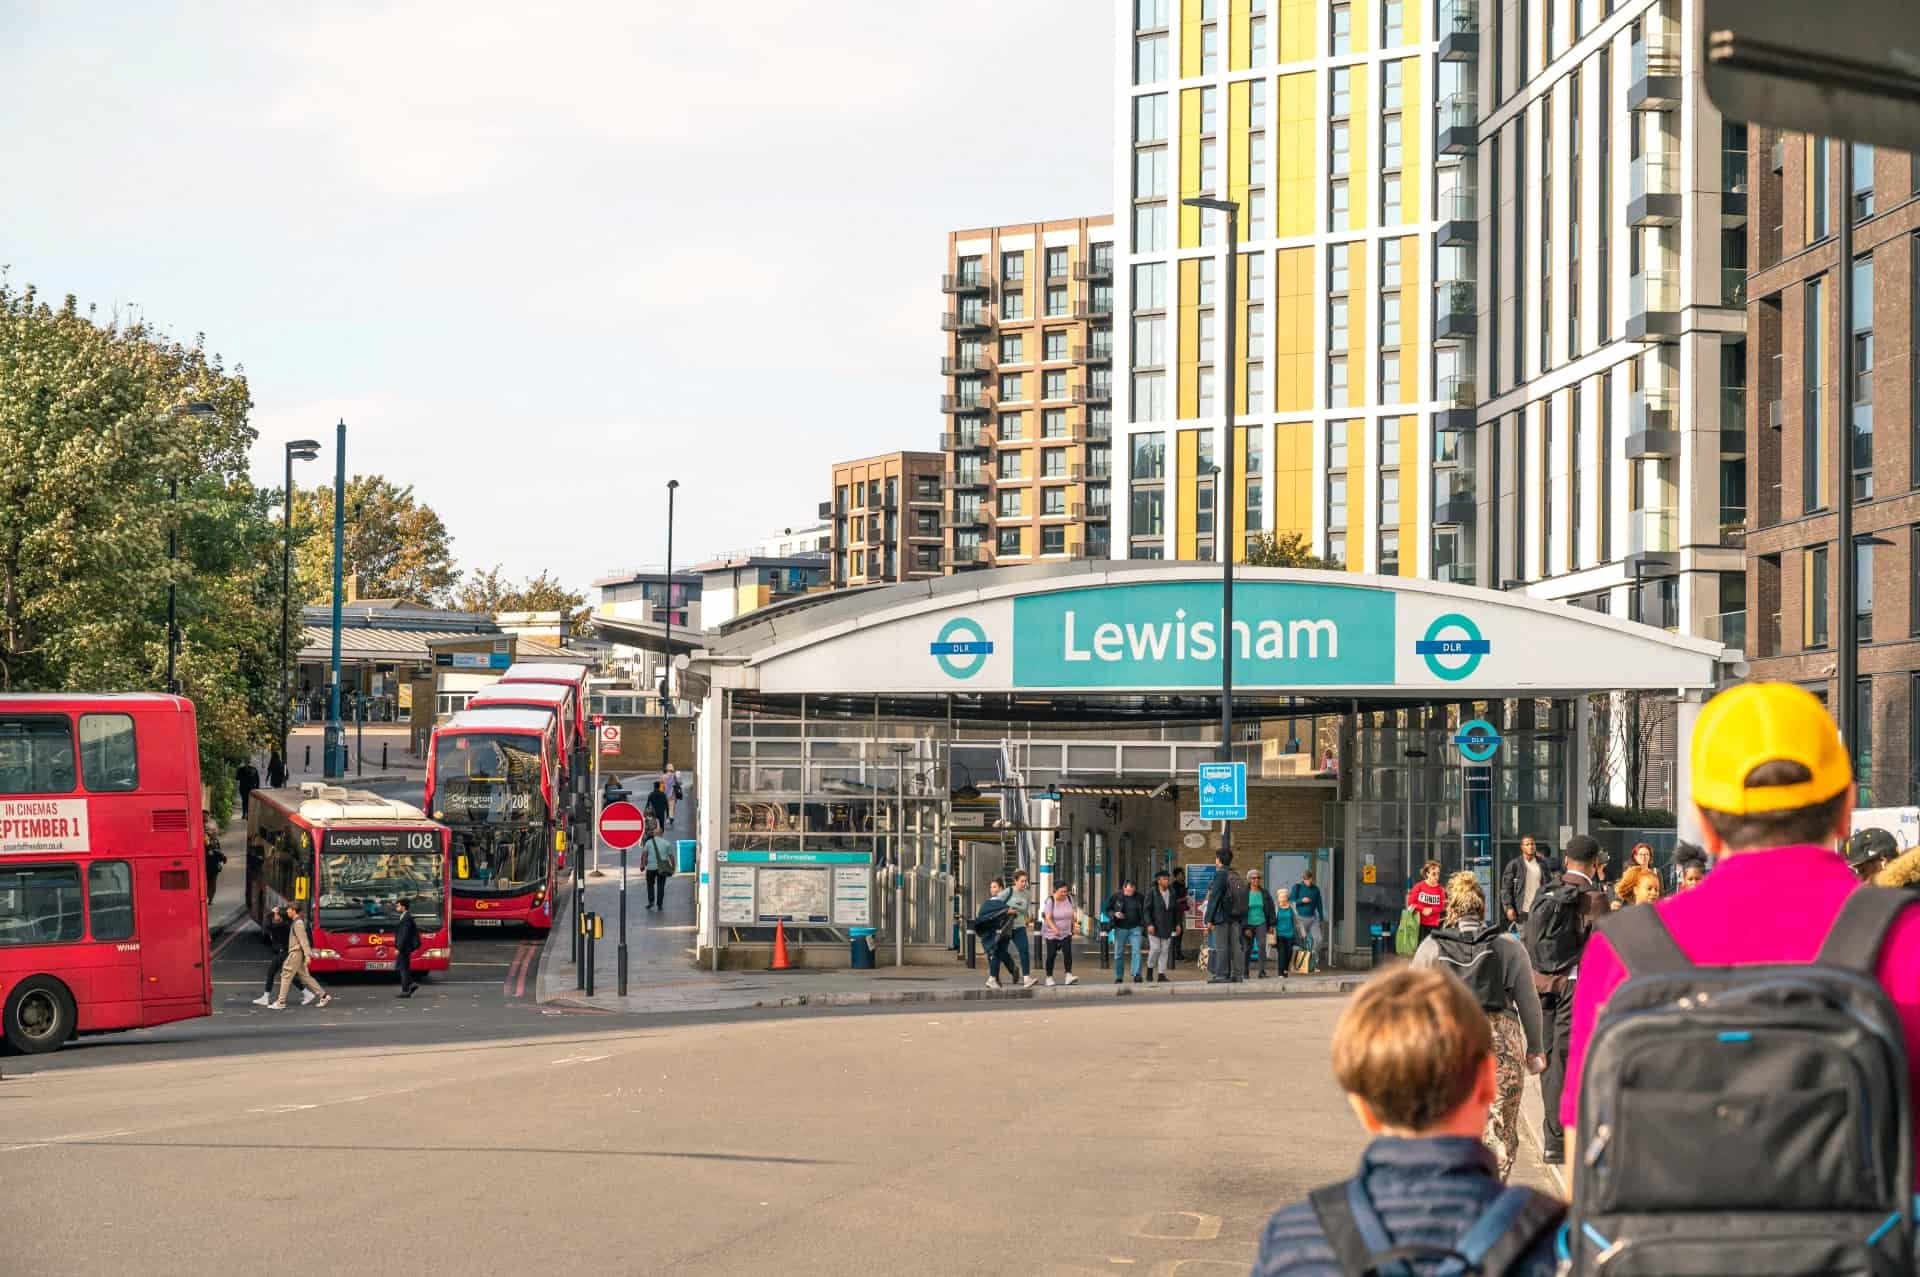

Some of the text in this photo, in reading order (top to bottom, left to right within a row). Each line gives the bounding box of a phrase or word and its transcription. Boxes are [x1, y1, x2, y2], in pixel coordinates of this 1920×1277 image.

[1064, 608, 1338, 661] Lewisham
[953, 643, 969, 653] DLR
[1443, 642, 1462, 652] DLR
[511, 793, 529, 809] 208
[5, 803, 58, 817] IN CINEMAS
[72, 817, 80, 837] 1
[330, 833, 433, 849] Lewisham 108
